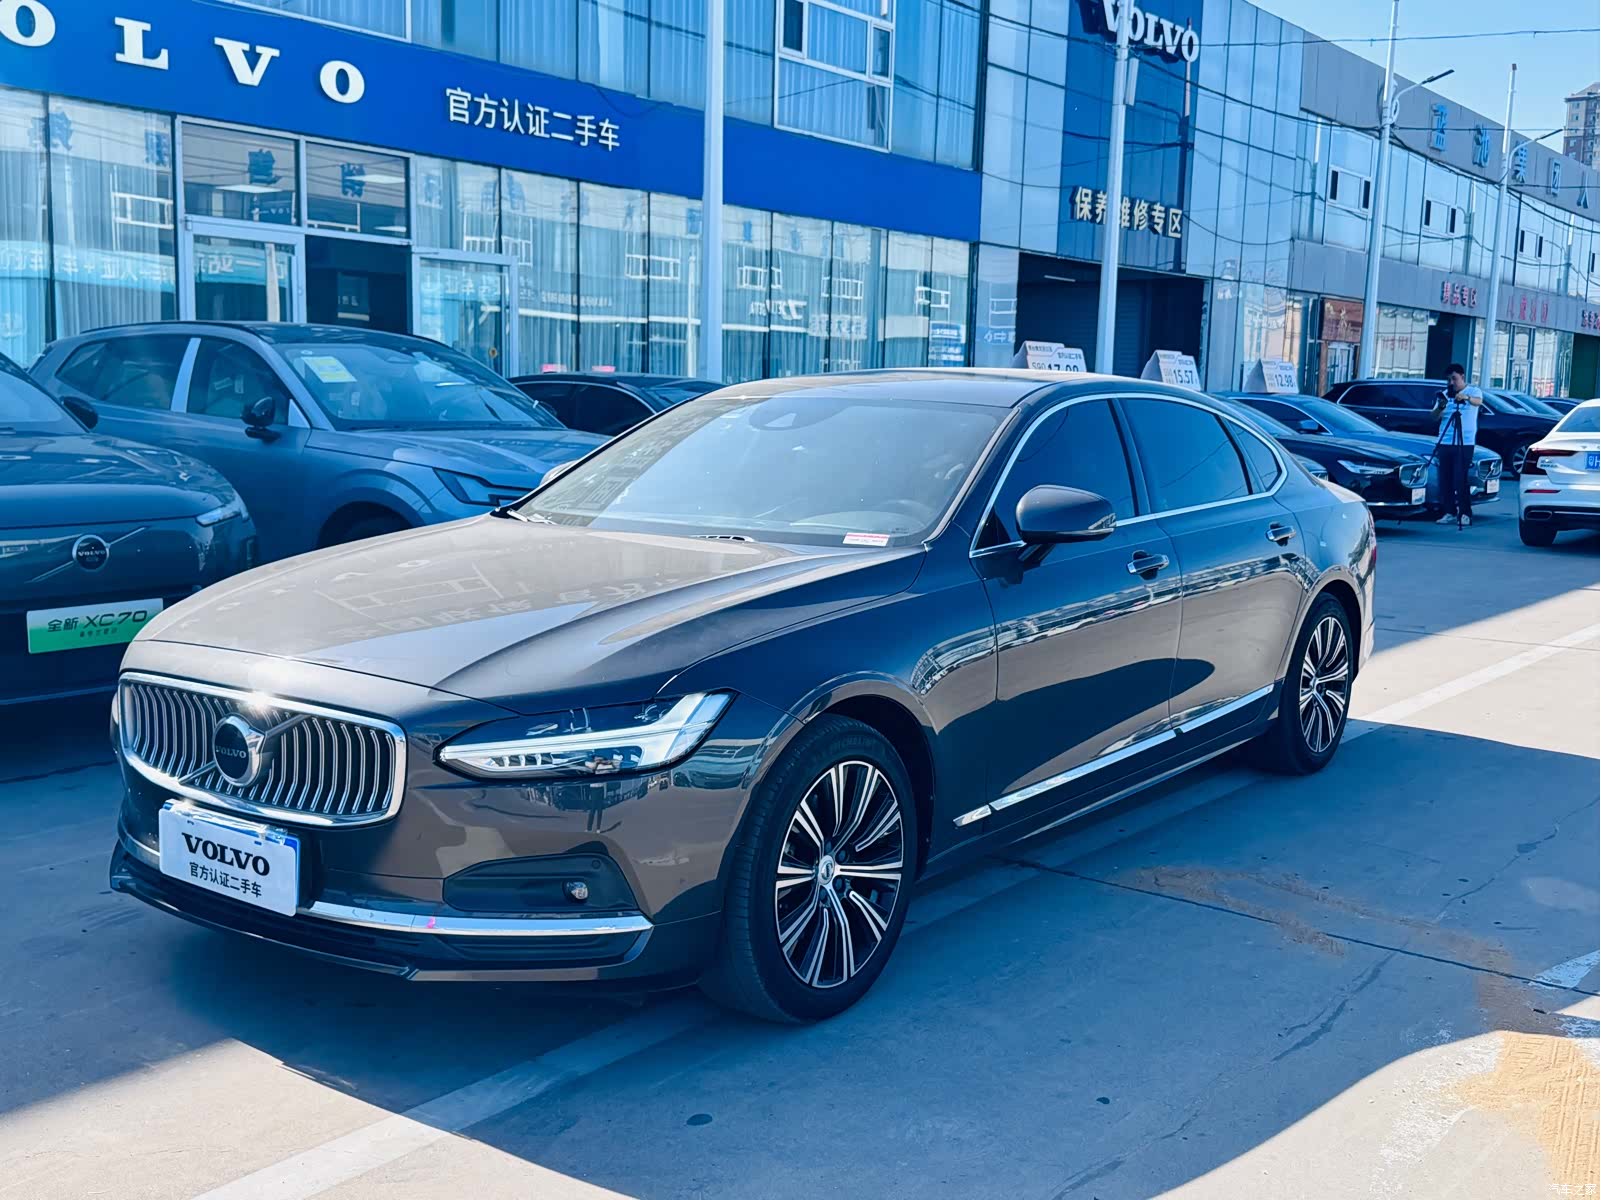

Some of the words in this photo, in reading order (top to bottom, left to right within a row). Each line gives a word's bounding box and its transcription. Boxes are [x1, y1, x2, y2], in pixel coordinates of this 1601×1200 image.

[1102, 0, 1200, 63] VOLVO
[445, 87, 621, 152] 官方认证二手车
[1075, 186, 1182, 238] 保养维修专区
[1173, 369, 1194, 385] 15.57
[78, 549, 106, 557] VOLVO
[47, 617, 79, 632] 全新
[83, 610, 148, 629] XC70
[215, 745, 247, 759] VOLVO
[181, 832, 270, 877] VOLVO
[189, 861, 262, 898] 官方认证二手车
